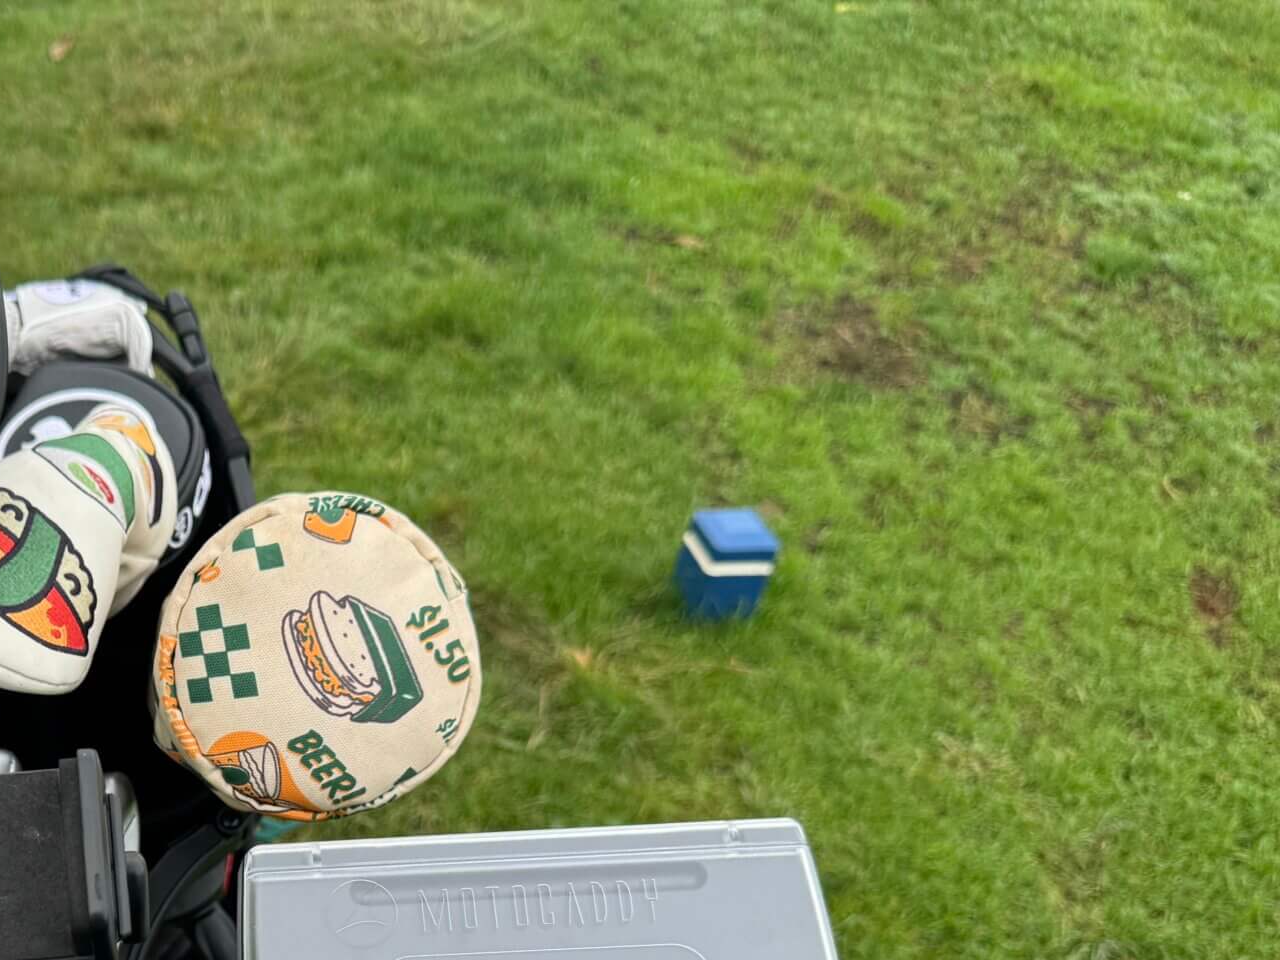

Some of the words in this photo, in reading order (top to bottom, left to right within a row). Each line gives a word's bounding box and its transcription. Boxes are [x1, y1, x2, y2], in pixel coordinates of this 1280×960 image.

[406, 605, 471, 684] $1.50
[287, 729, 367, 804] BEER!
[418, 878, 660, 934] MOTOCADDY
